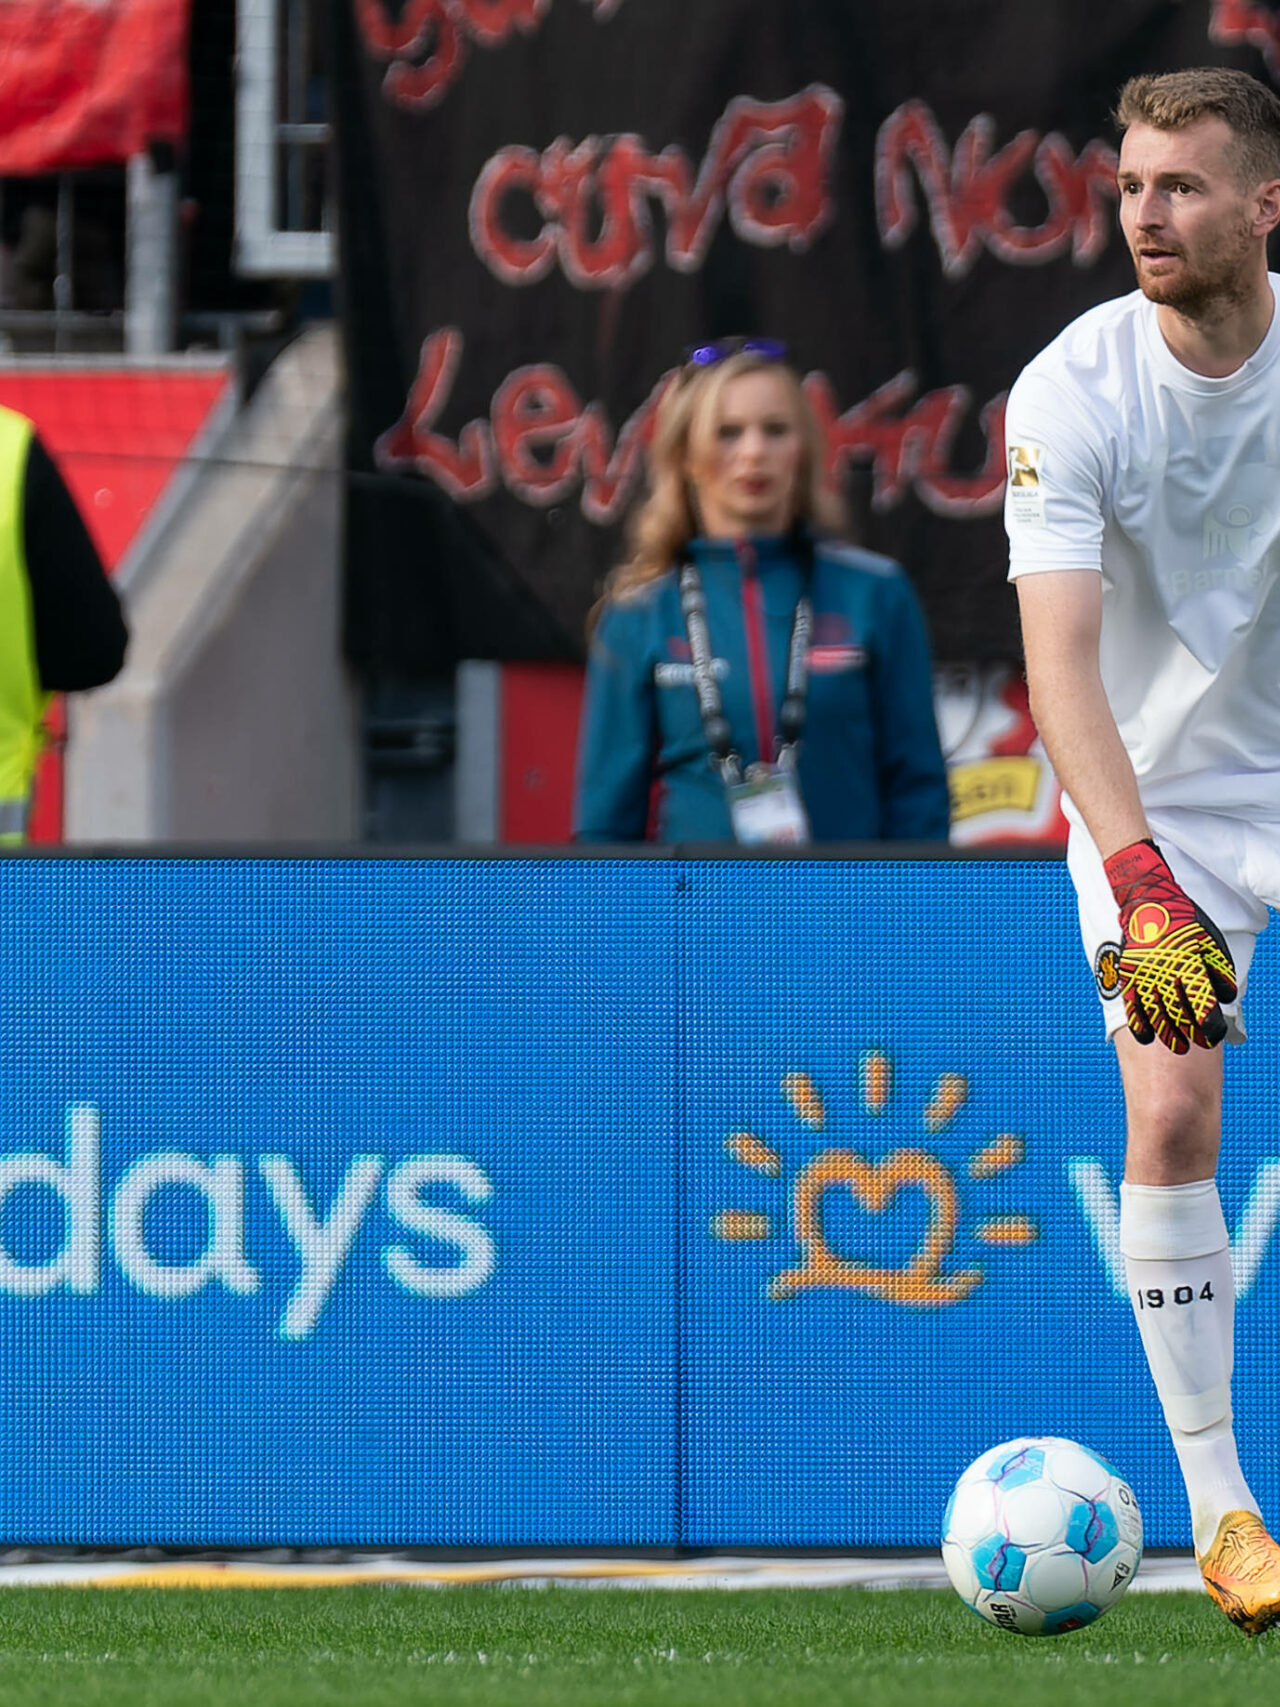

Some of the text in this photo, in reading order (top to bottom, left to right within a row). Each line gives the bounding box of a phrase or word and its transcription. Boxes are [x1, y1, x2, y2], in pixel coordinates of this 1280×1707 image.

[875, 98, 1120, 278] Nor
[0, 1100, 499, 1343] days
[1137, 1281, 1214, 1310] 1904
